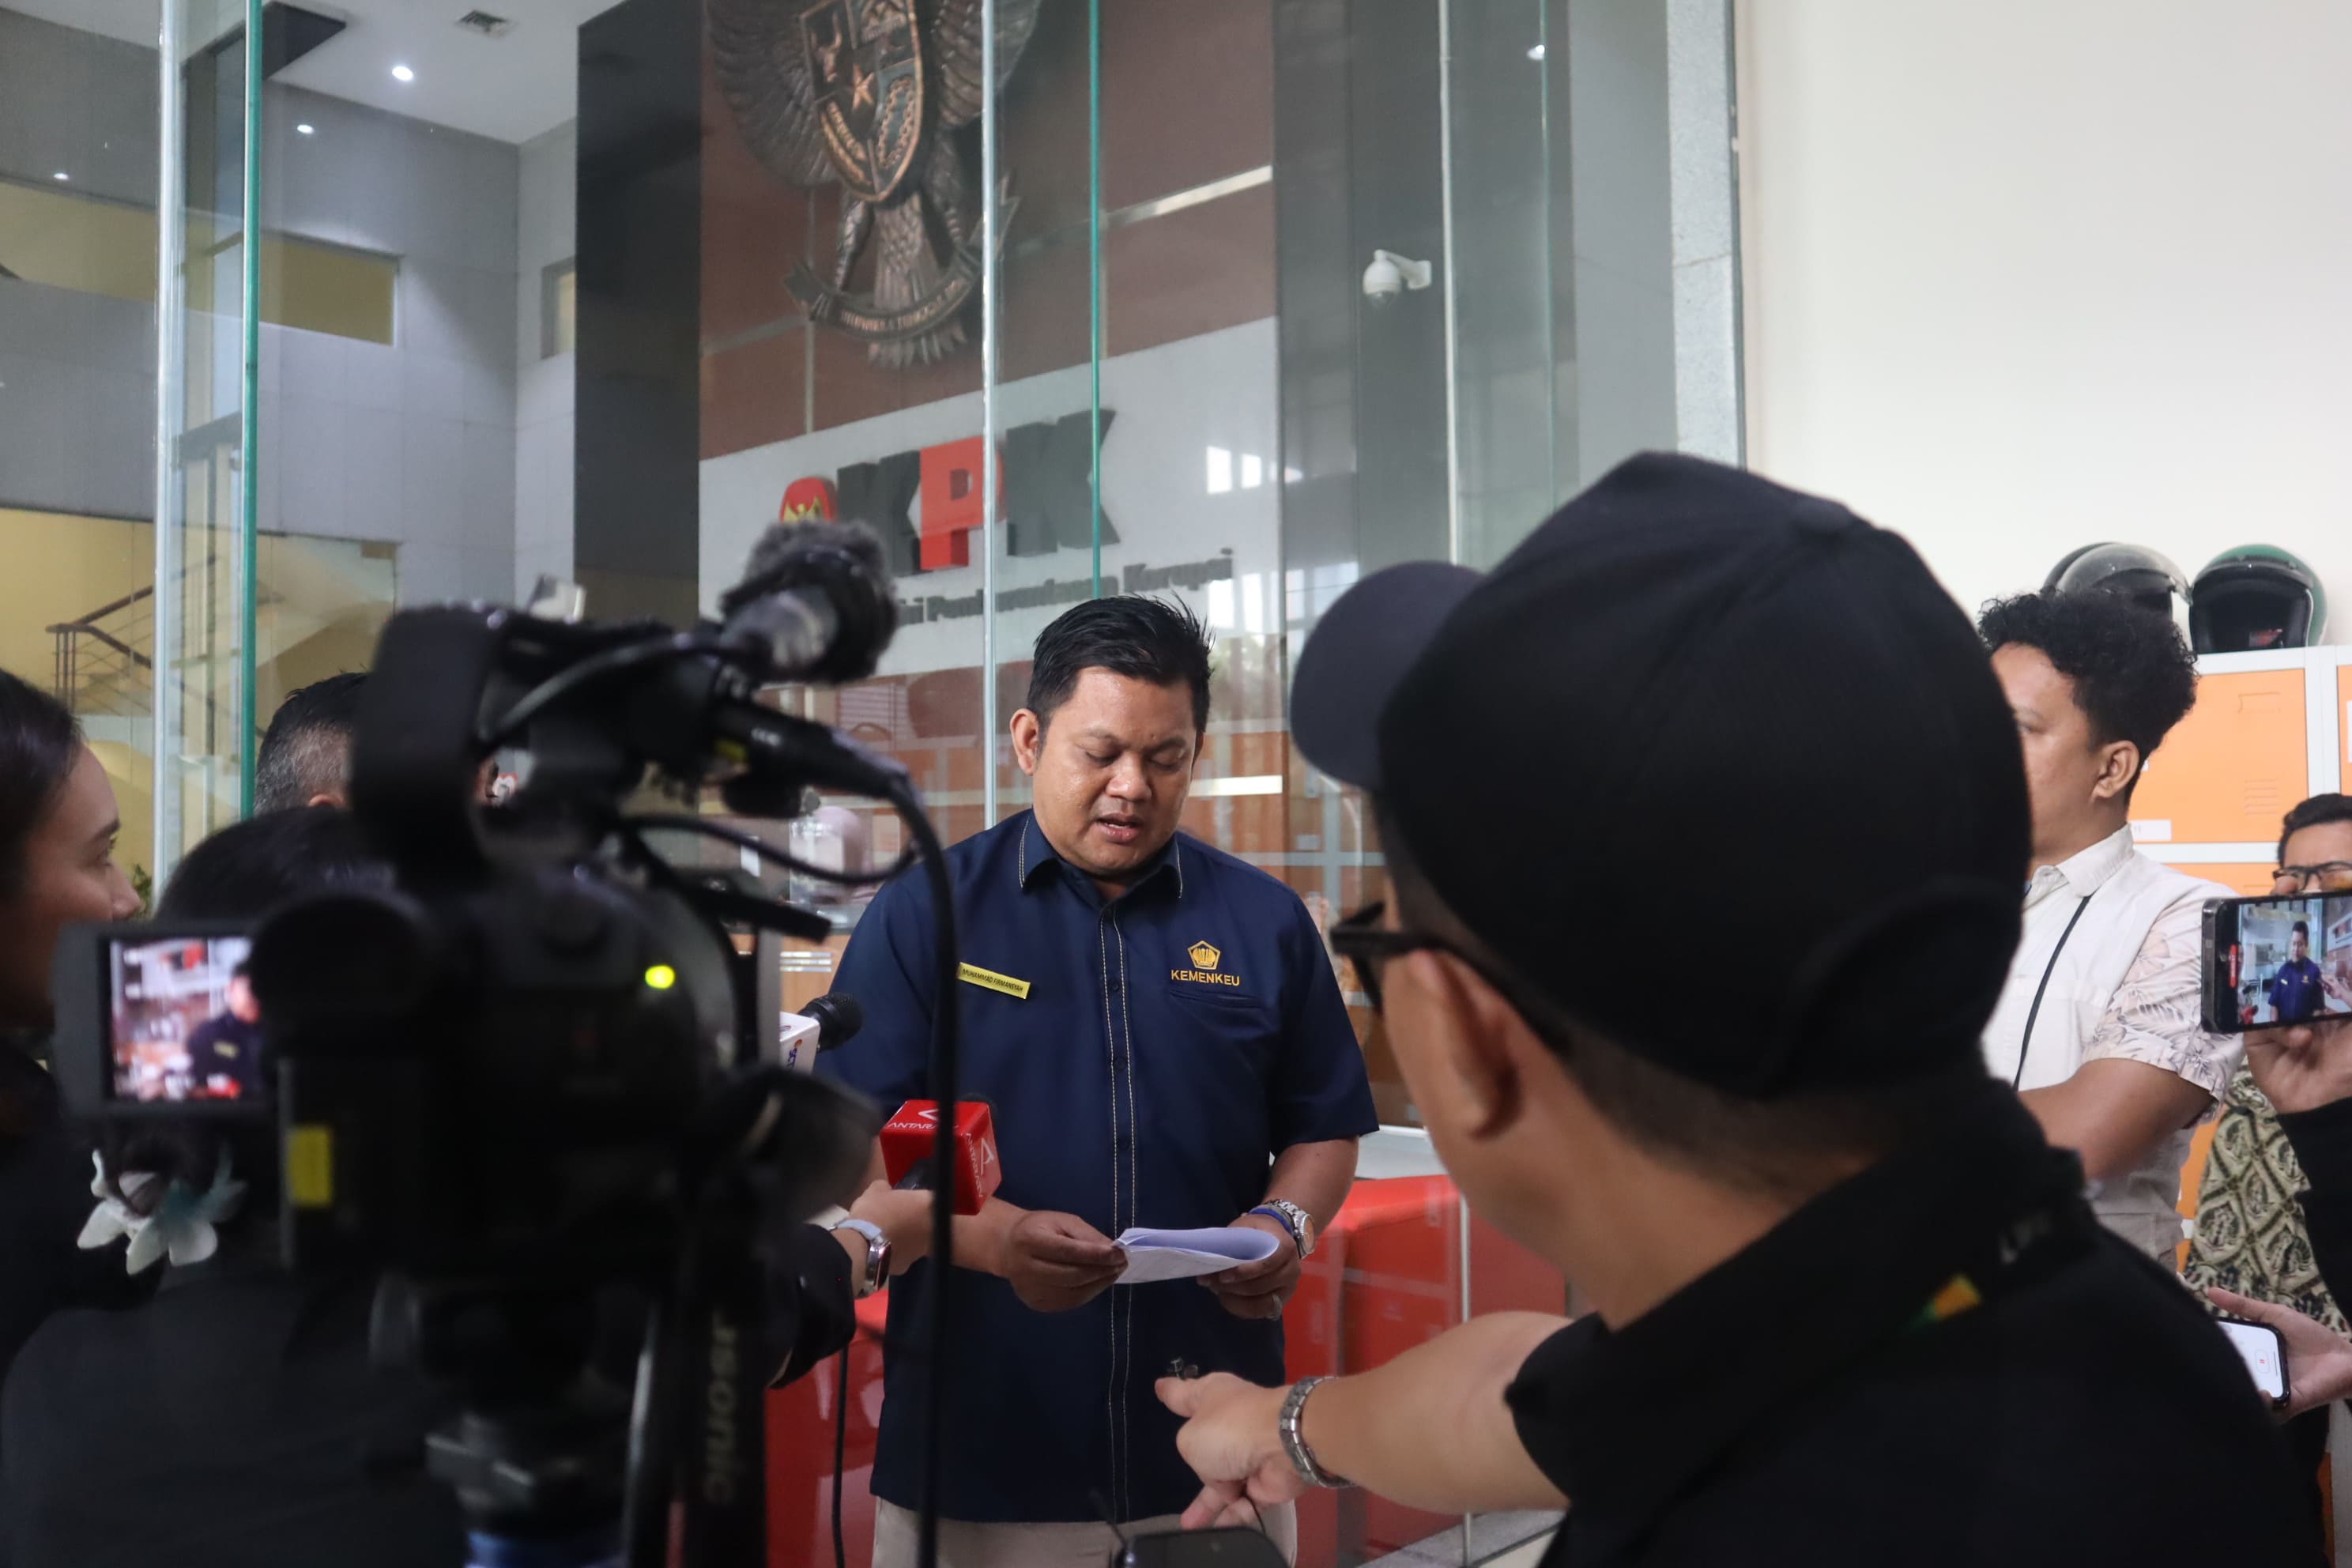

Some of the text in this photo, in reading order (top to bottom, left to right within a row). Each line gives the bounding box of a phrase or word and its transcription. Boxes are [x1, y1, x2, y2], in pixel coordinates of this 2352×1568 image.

[837, 409, 1120, 577] KPK
[963, 969, 1023, 993] MUHAMMAD FIRMANSYAH
[1170, 970, 1240, 986] KEMENKEU
